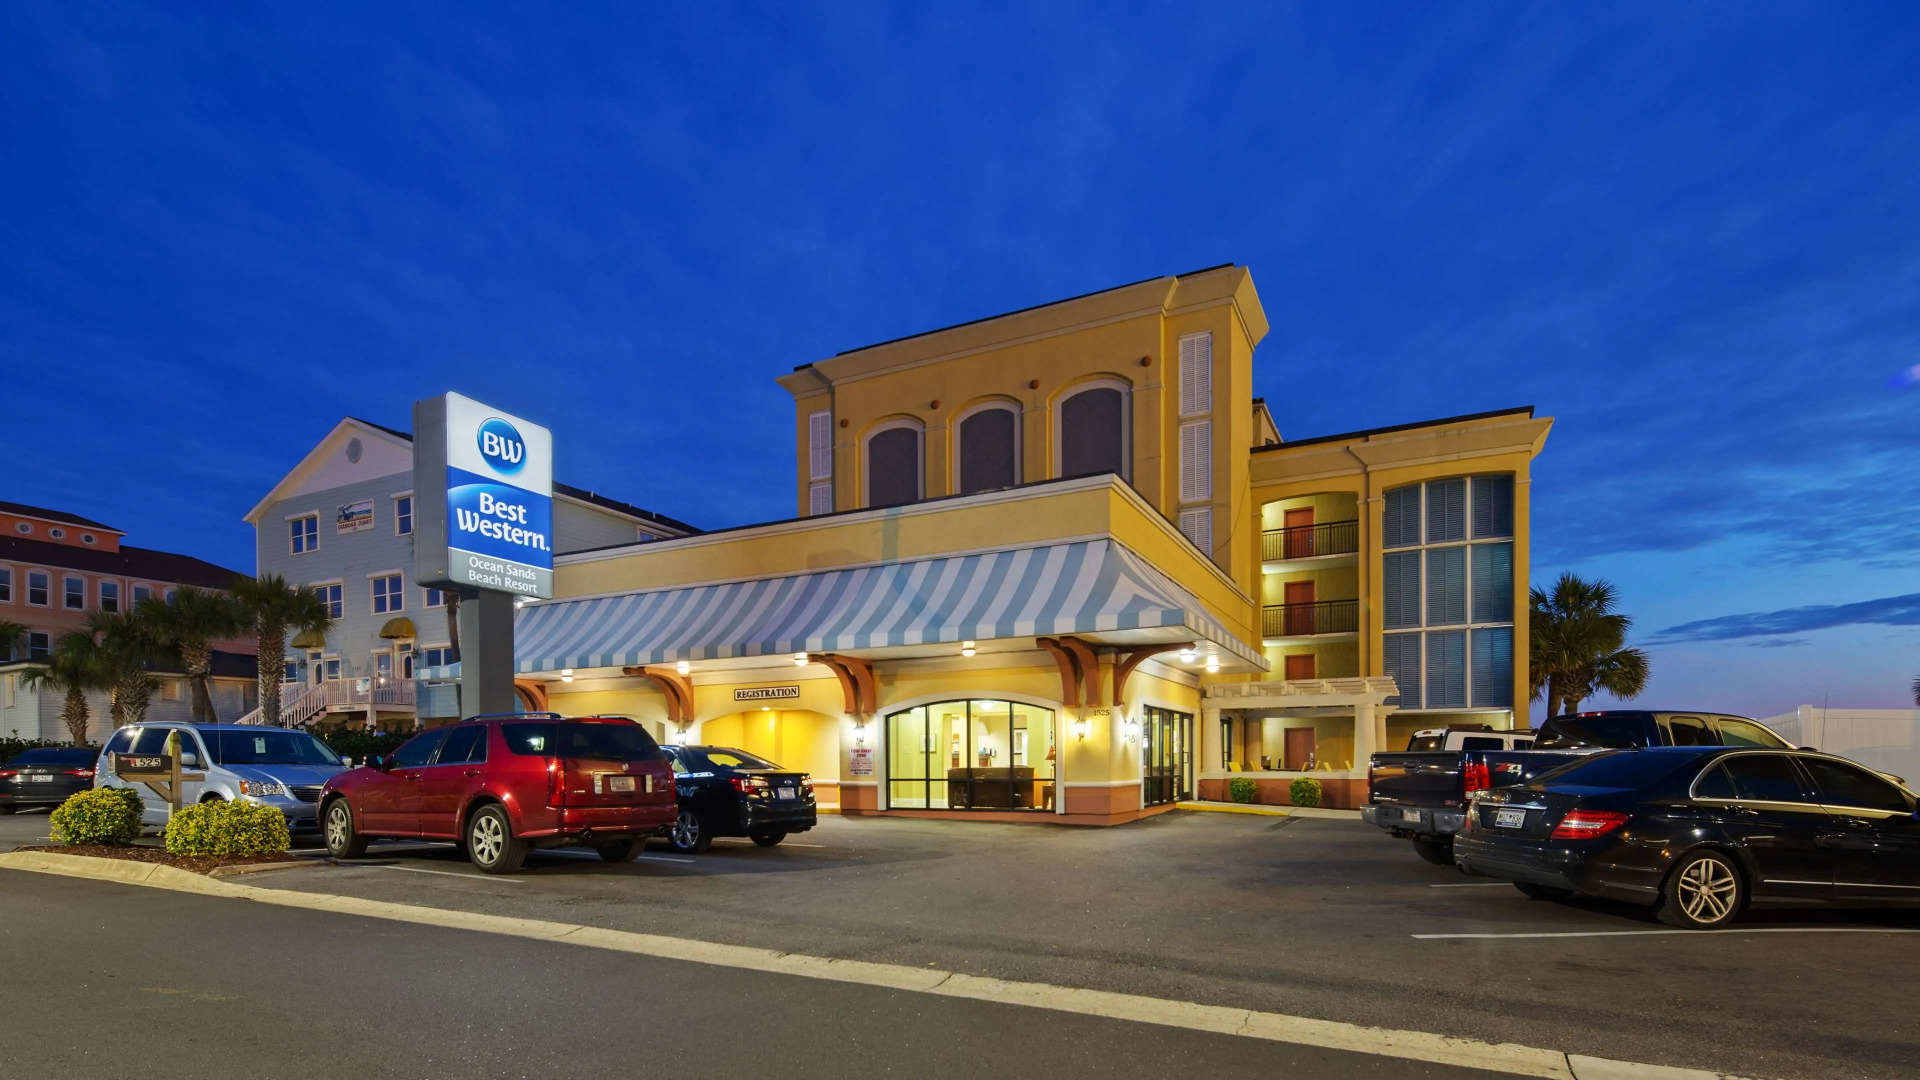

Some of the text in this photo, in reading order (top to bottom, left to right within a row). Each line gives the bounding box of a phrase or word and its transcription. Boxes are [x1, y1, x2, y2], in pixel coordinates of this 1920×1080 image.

[483, 430, 522, 464] BW
[479, 492, 527, 525] Best
[338, 522, 356, 530] DIAMOND
[469, 556, 536, 581] Ocean Sands
[468, 569, 538, 594] Beach Resort
[736, 687, 797, 699] REGISTRATION
